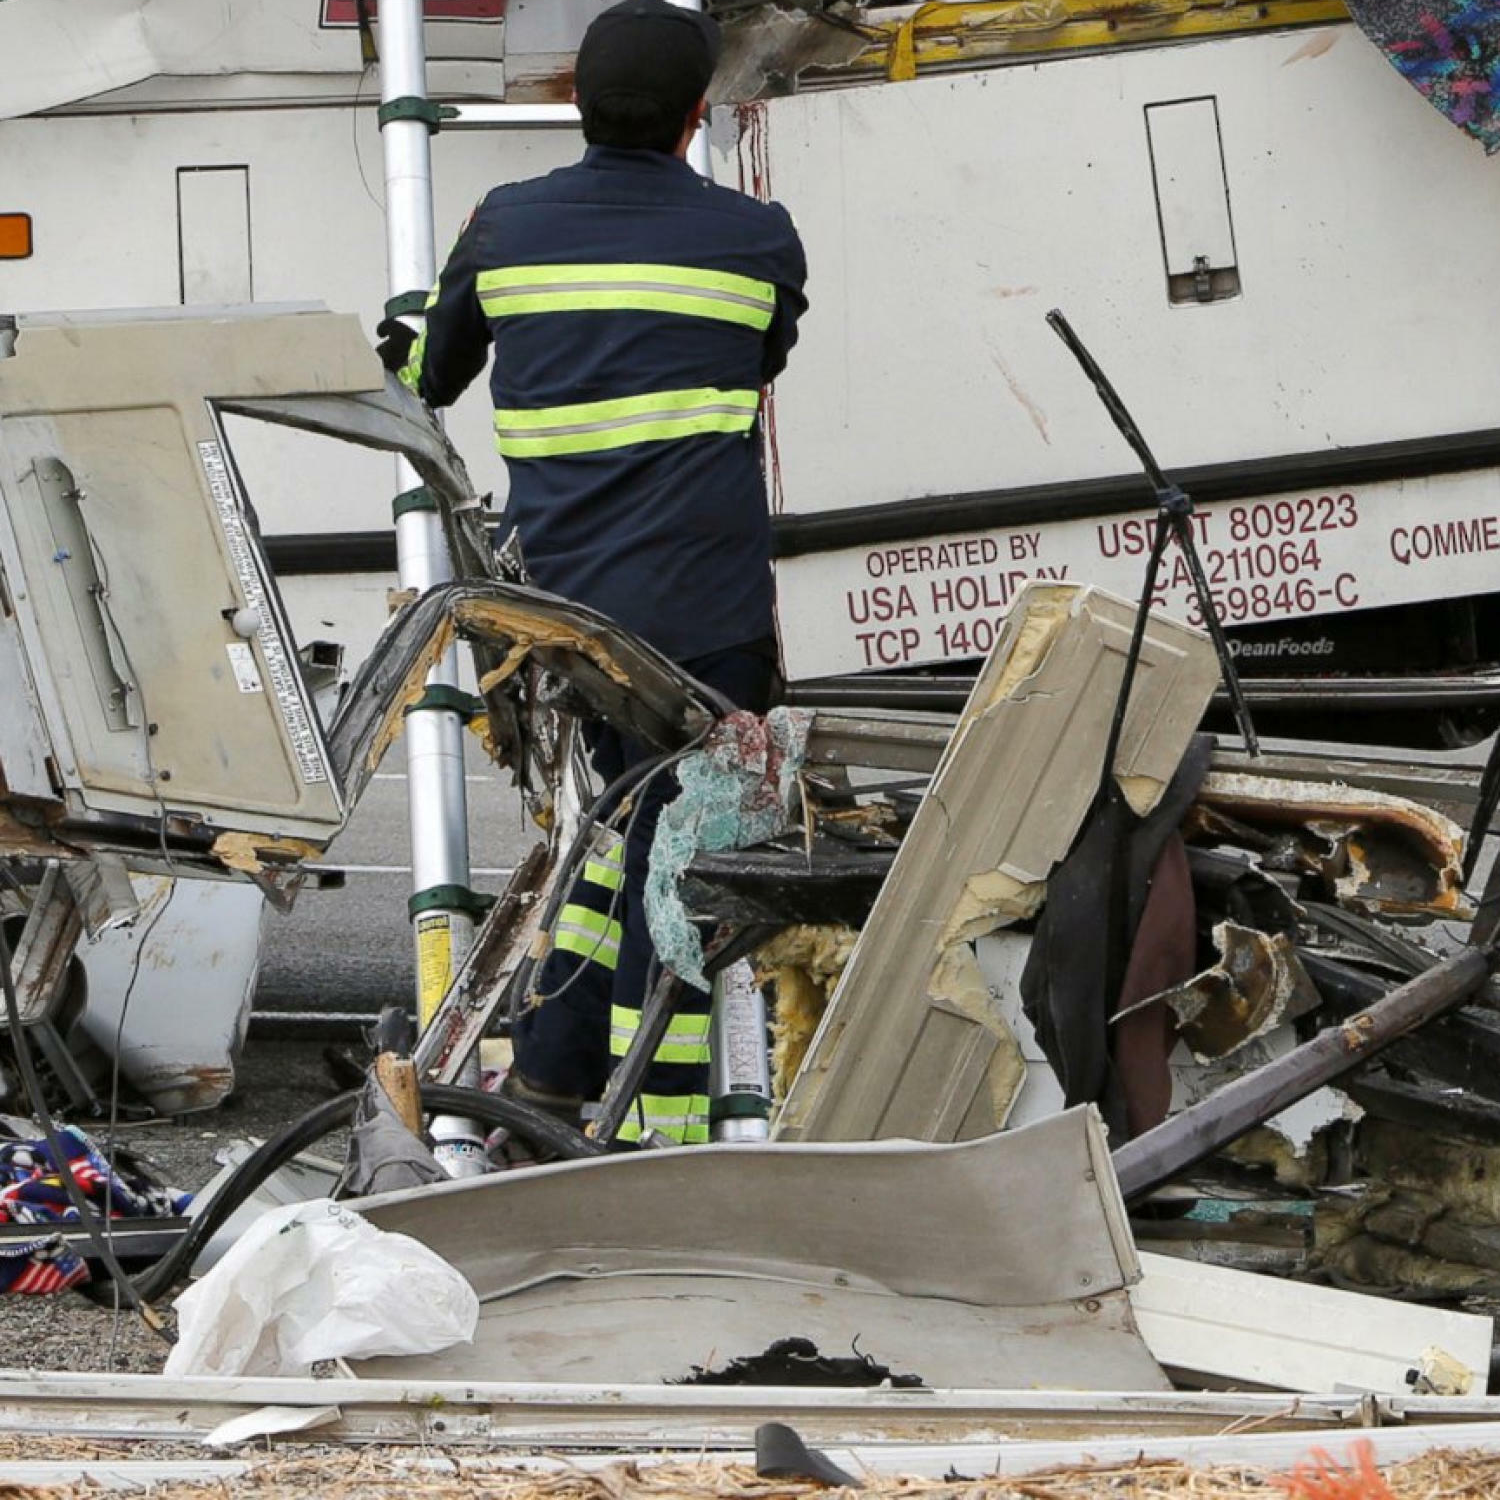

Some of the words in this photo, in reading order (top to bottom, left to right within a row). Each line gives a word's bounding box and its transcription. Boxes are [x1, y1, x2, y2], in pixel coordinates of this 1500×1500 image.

[1230, 493, 1359, 542] 809223
[866, 538, 999, 578] OPERATED
[1009, 532, 1041, 561] BY
[1206, 538, 1322, 585] 211064
[846, 584, 918, 624] USA
[1185, 572, 1360, 627] 359846-C
[855, 628, 921, 667] TCP
